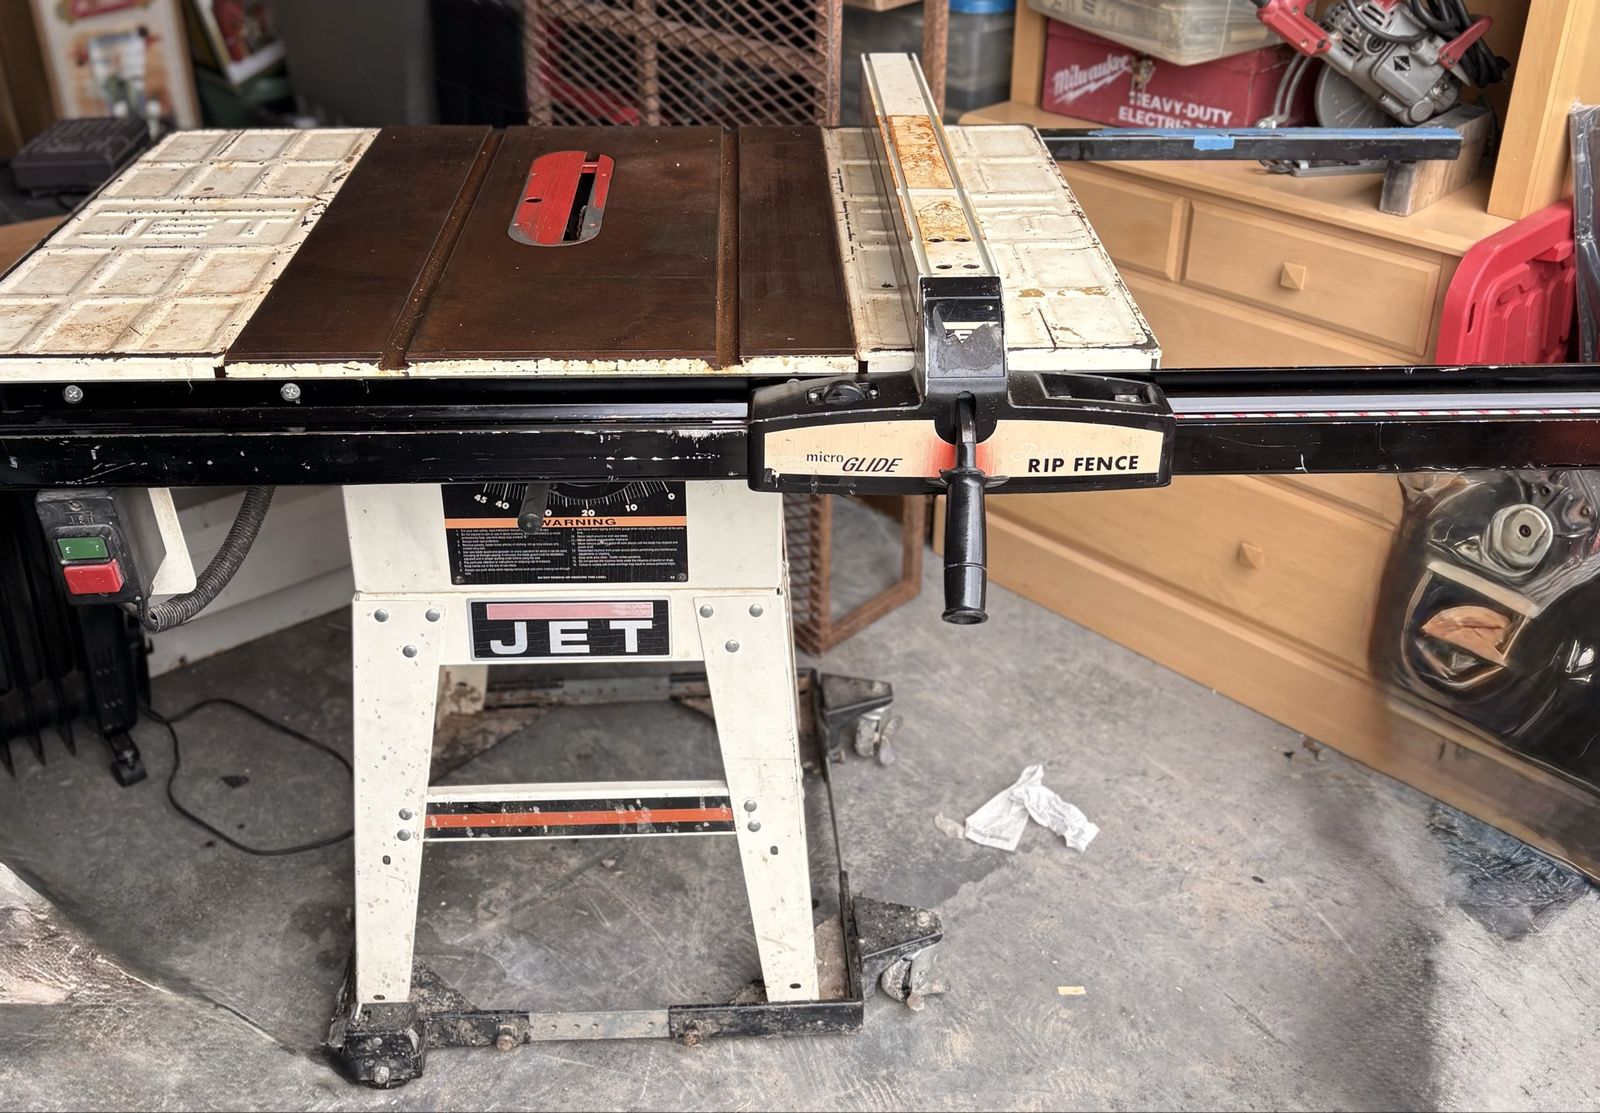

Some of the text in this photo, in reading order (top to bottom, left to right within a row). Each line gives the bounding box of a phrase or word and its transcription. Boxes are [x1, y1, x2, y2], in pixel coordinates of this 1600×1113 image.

[1053, 53, 1130, 97] Milwaukee
[1129, 91, 1232, 125] HEAVY-DUTY
[806, 451, 903, 472] micro GLIDE
[1028, 455, 1139, 473] RIP FENCE
[474, 494, 487, 504] 45
[495, 501, 509, 510] 40
[545, 509, 552, 517] 0
[581, 509, 595, 517] 20
[625, 504, 638, 512] 10
[541, 518, 617, 527] WARNING
[490, 621, 653, 655] JET
